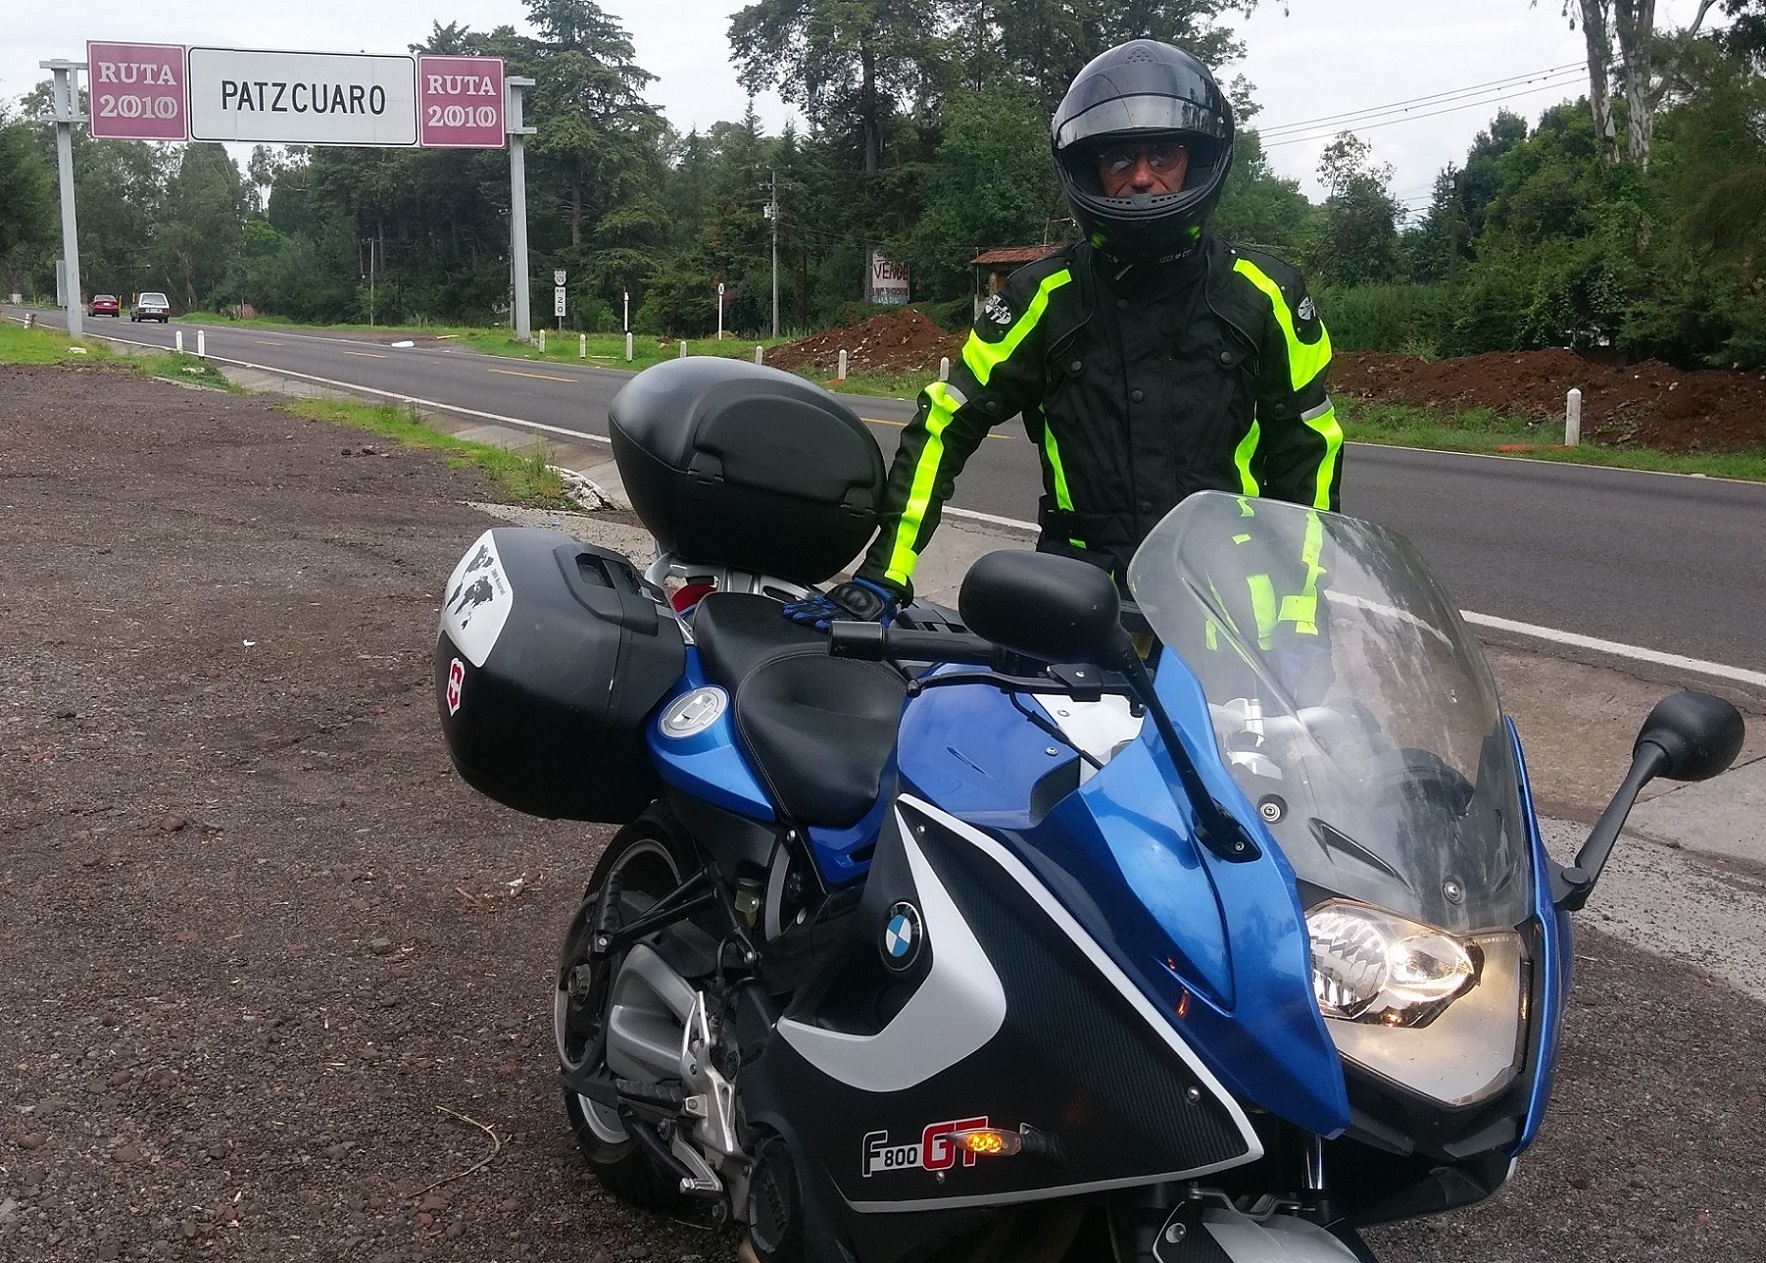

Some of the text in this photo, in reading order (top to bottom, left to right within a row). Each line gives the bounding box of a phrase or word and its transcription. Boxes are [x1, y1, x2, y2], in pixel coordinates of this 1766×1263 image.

[98, 62, 177, 85] RUTA
[427, 74, 497, 96] RUTA
[99, 94, 178, 119] 2010
[221, 80, 386, 115] PATZCUARO
[427, 105, 497, 128] 2010
